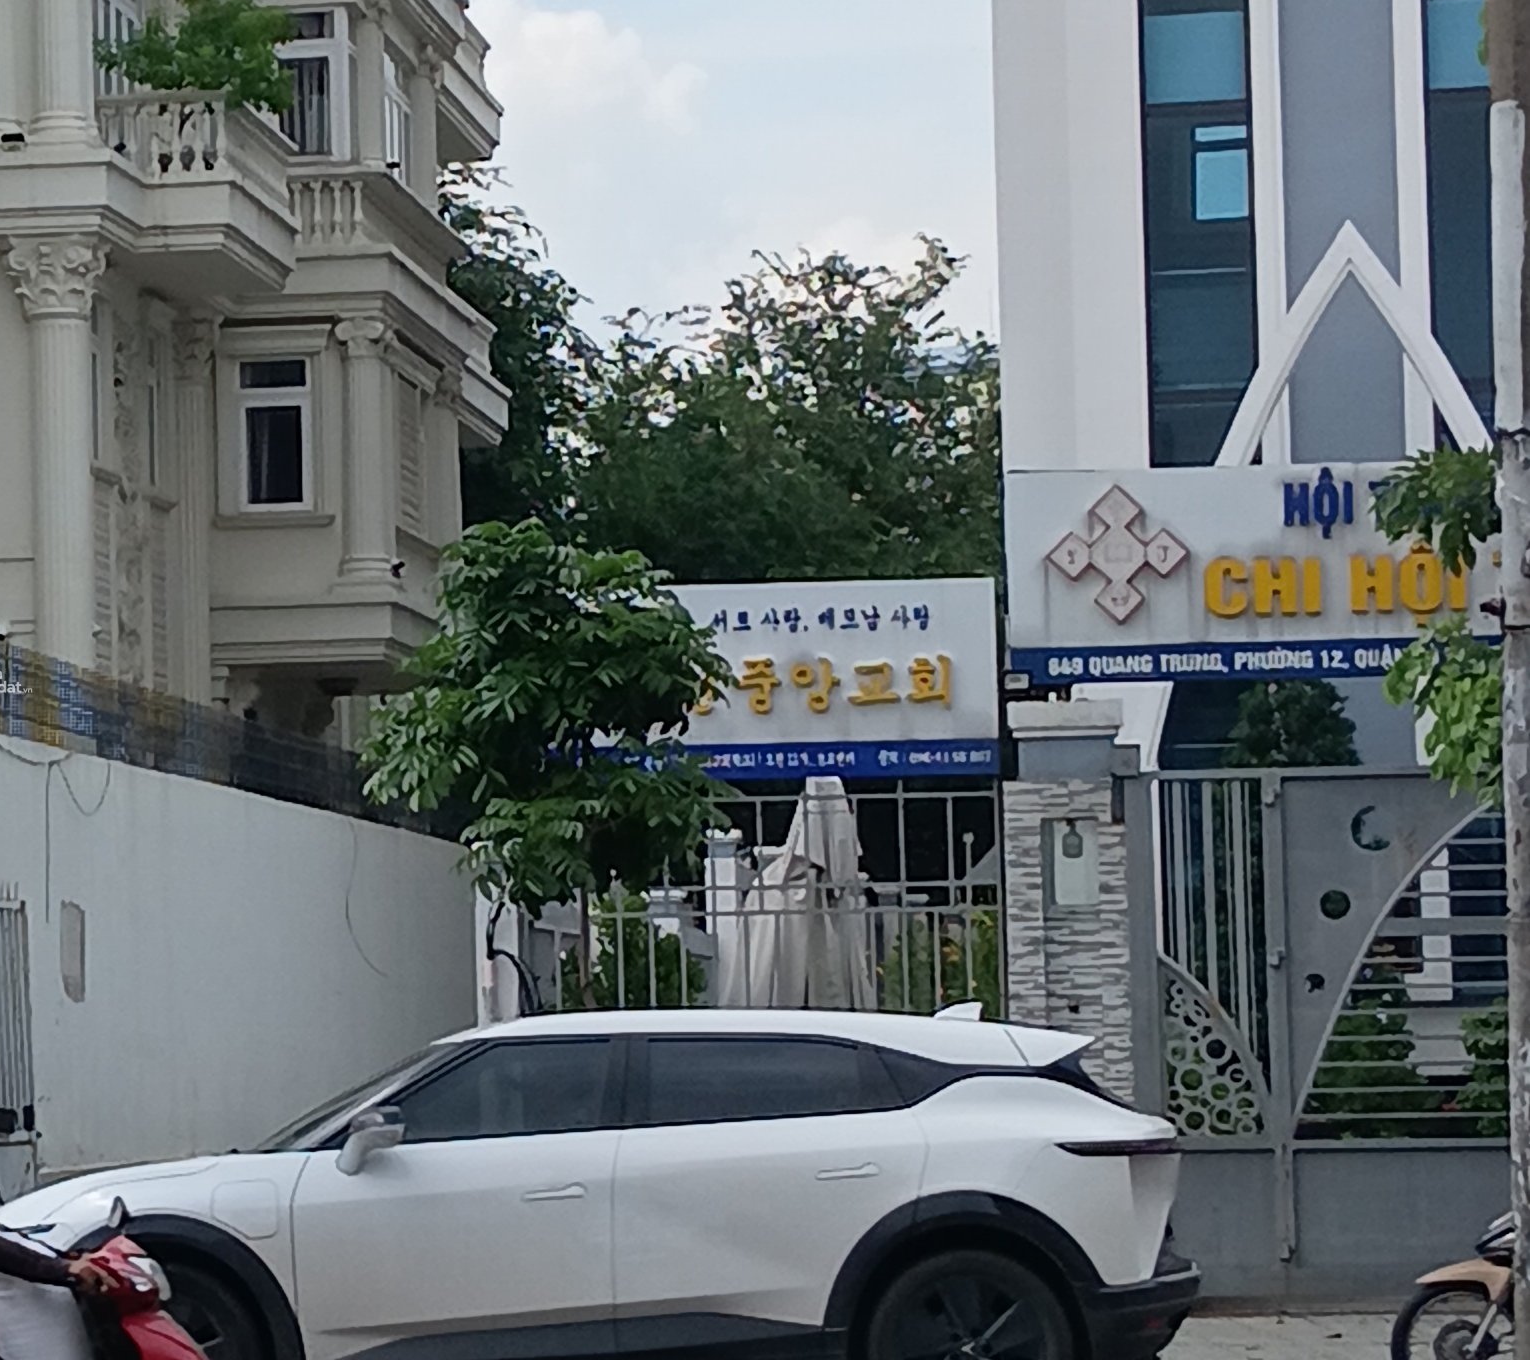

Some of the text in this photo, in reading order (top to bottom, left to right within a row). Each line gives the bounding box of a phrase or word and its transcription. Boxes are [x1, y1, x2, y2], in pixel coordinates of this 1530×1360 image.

[1283, 466, 1354, 539] HỘI
[1203, 539, 1469, 628] CHI HỘI
[692, 653, 953, 716] 중앙교회
[1088, 653, 1153, 676] QUANG
